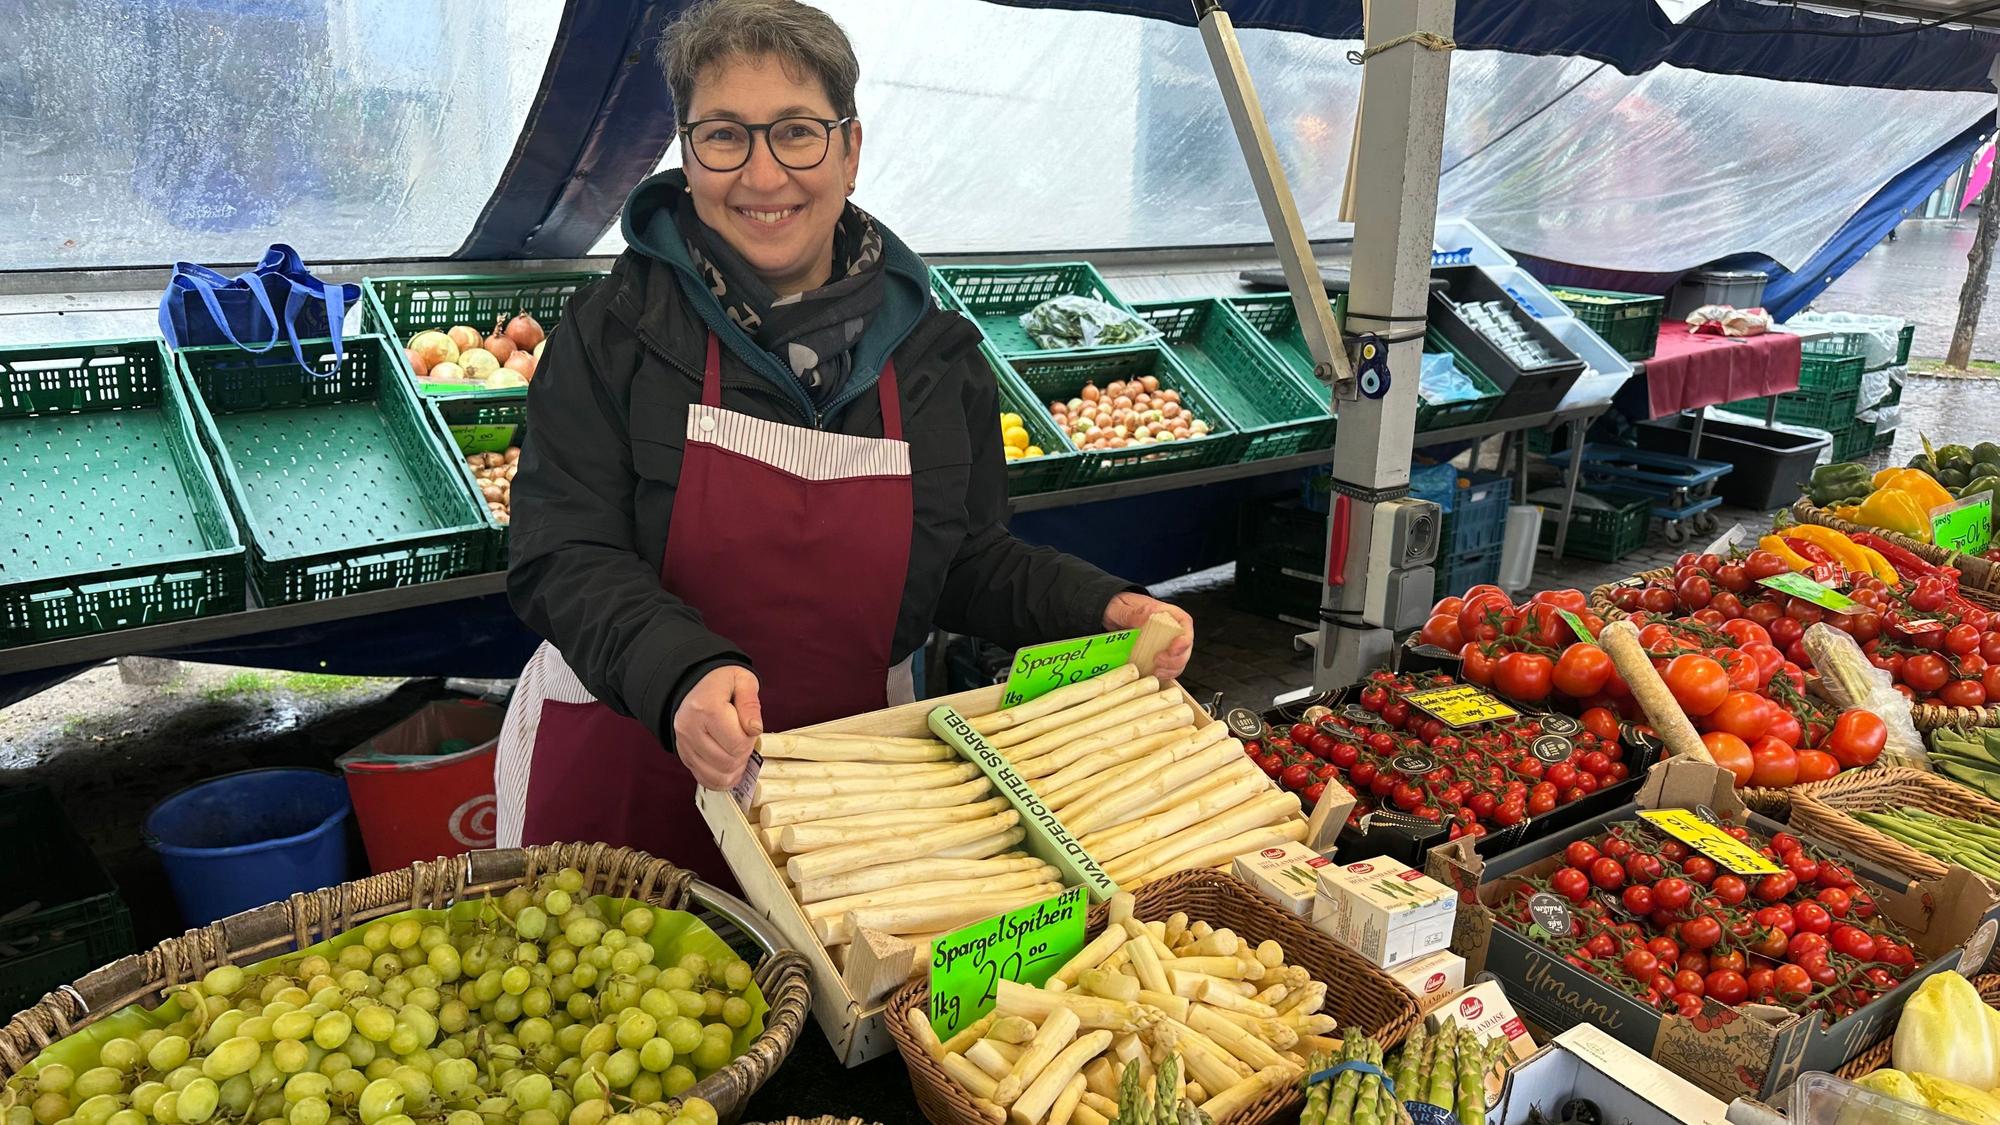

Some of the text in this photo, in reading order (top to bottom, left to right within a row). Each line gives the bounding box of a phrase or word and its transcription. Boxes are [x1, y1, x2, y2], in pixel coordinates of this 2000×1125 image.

[1015, 638, 1094, 680] Spargel
[1105, 631, 1131, 645] 1270
[944, 709, 1112, 889] WALDFEUCHTER SPARGEL
[1057, 888, 1081, 907] 1271
[933, 990, 960, 1031] 1kg
[978, 951, 1022, 1008] 20
[1524, 951, 1624, 1030] Umami
[1472, 1012, 1507, 1034] LANDAISE
